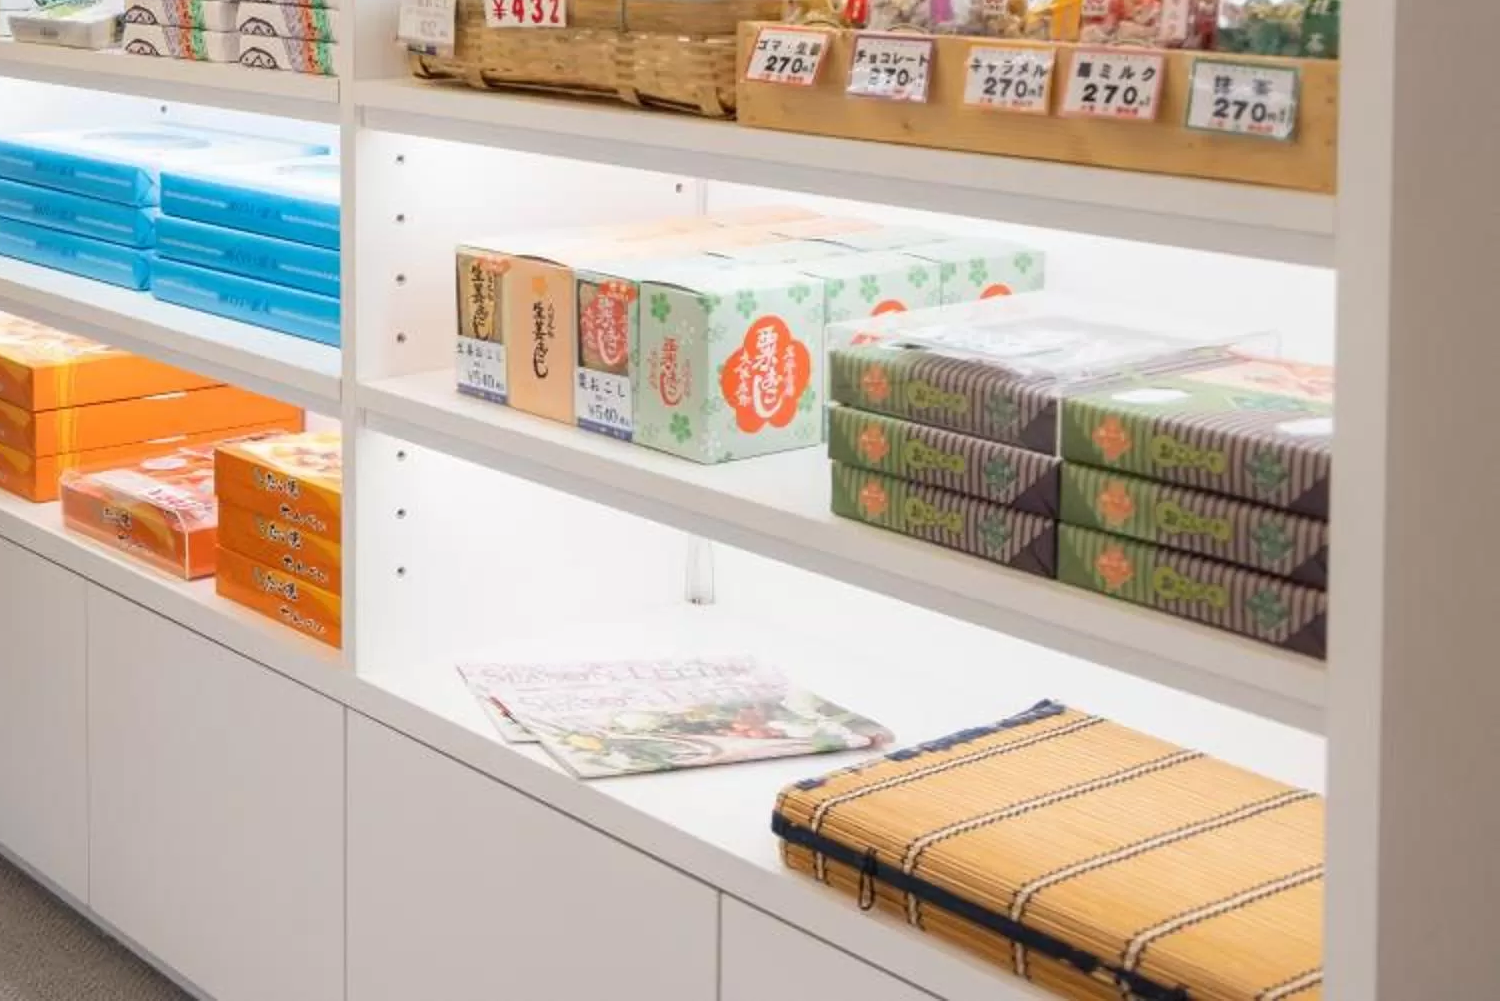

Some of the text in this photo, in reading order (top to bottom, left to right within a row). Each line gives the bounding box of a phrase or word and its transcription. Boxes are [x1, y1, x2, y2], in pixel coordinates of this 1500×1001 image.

[855, 49, 928, 67] チョコレート
[970, 58, 1048, 78] キャラメル
